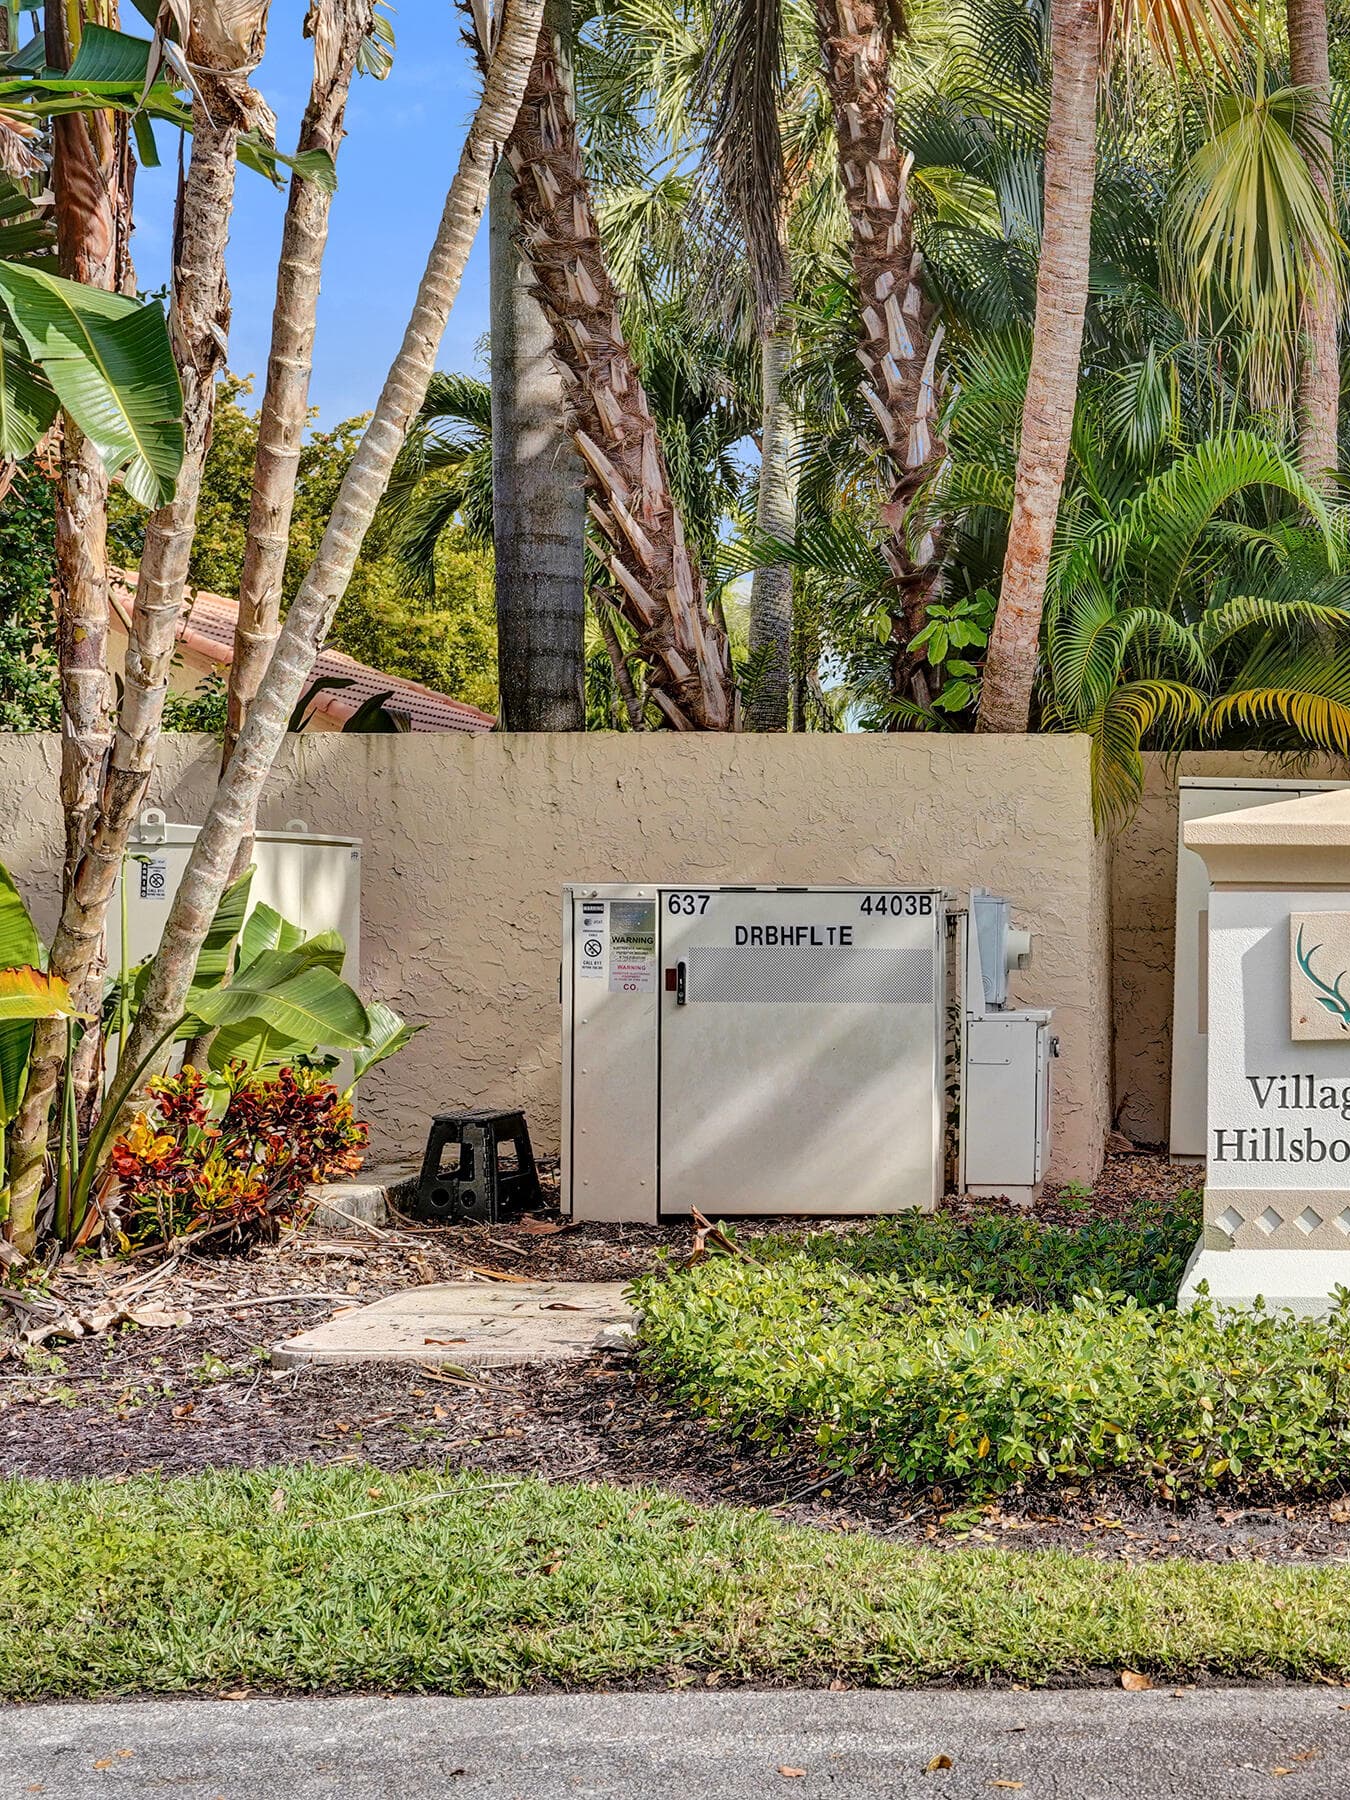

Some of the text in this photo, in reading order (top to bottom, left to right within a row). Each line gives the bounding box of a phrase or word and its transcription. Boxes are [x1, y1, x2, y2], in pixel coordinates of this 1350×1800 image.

[668, 893, 711, 915] 637
[860, 894, 933, 916] 4403B
[612, 936, 654, 944] WARNING
[735, 925, 853, 946] DRBHFLTE
